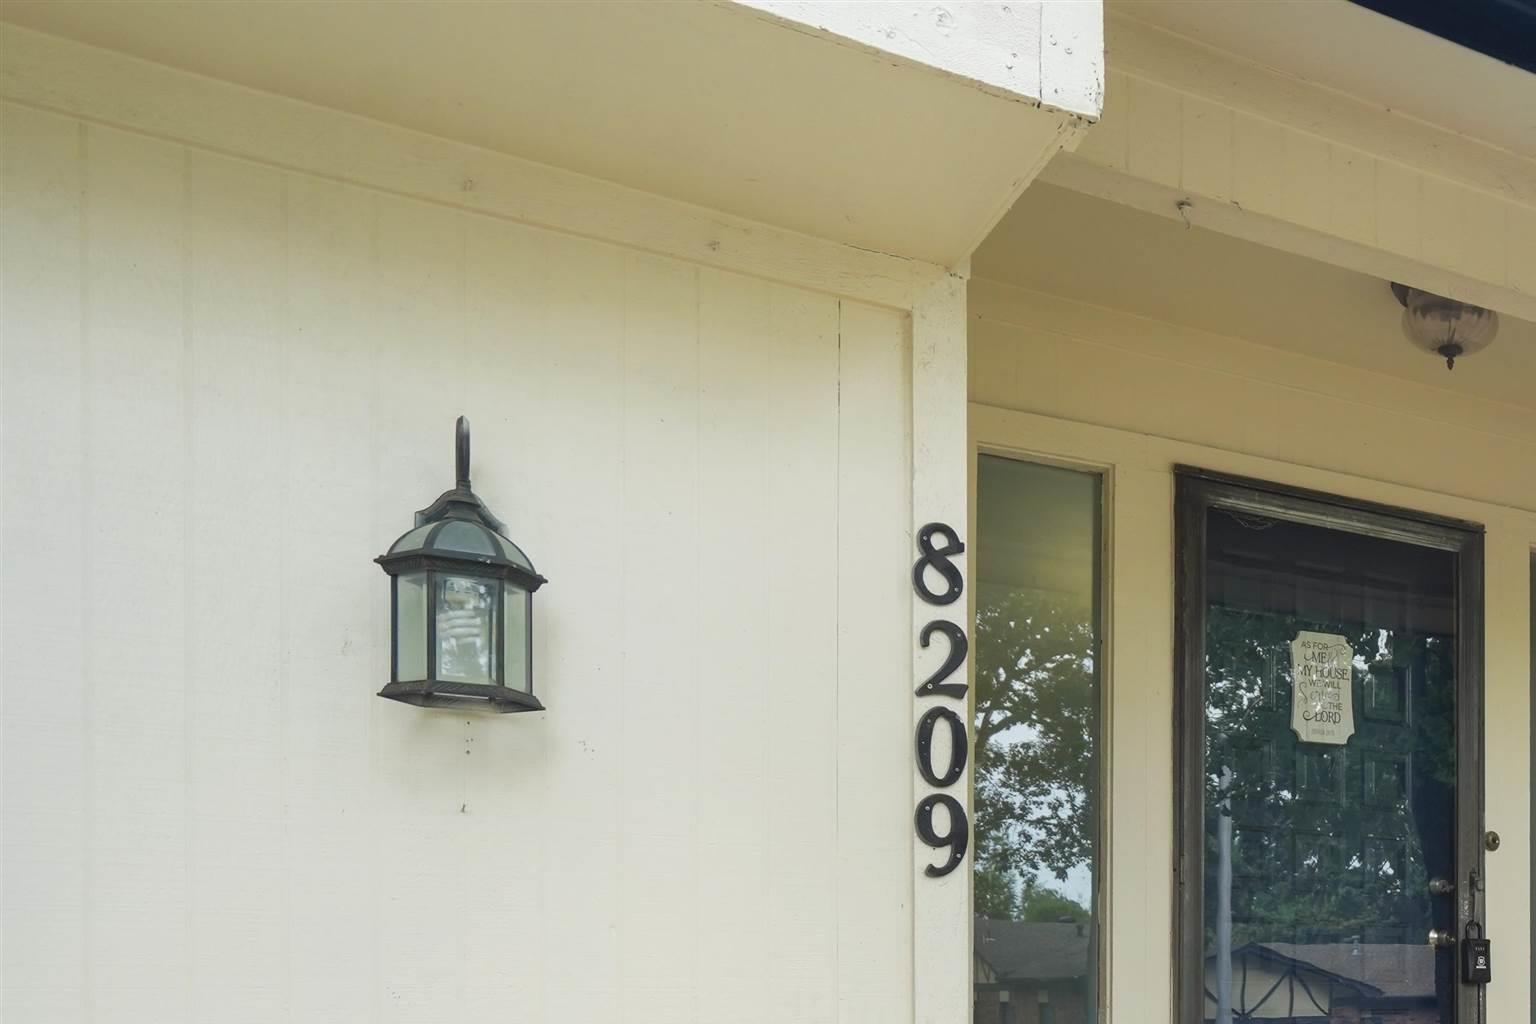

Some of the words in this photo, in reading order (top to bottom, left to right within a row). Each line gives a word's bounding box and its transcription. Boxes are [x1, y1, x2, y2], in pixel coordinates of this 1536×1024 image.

[1301, 640, 1312, 649] AS
[1313, 642, 1330, 651] FOR
[1306, 651, 1327, 664] ME
[1297, 663, 1313, 677] MY
[1315, 665, 1350, 681] HOUSE
[1308, 678, 1323, 688] WE
[1323, 680, 1341, 690] WILL
[912, 522, 969, 878] 8209
[1328, 701, 1343, 711] THE
[1309, 711, 1342, 725] LORD
